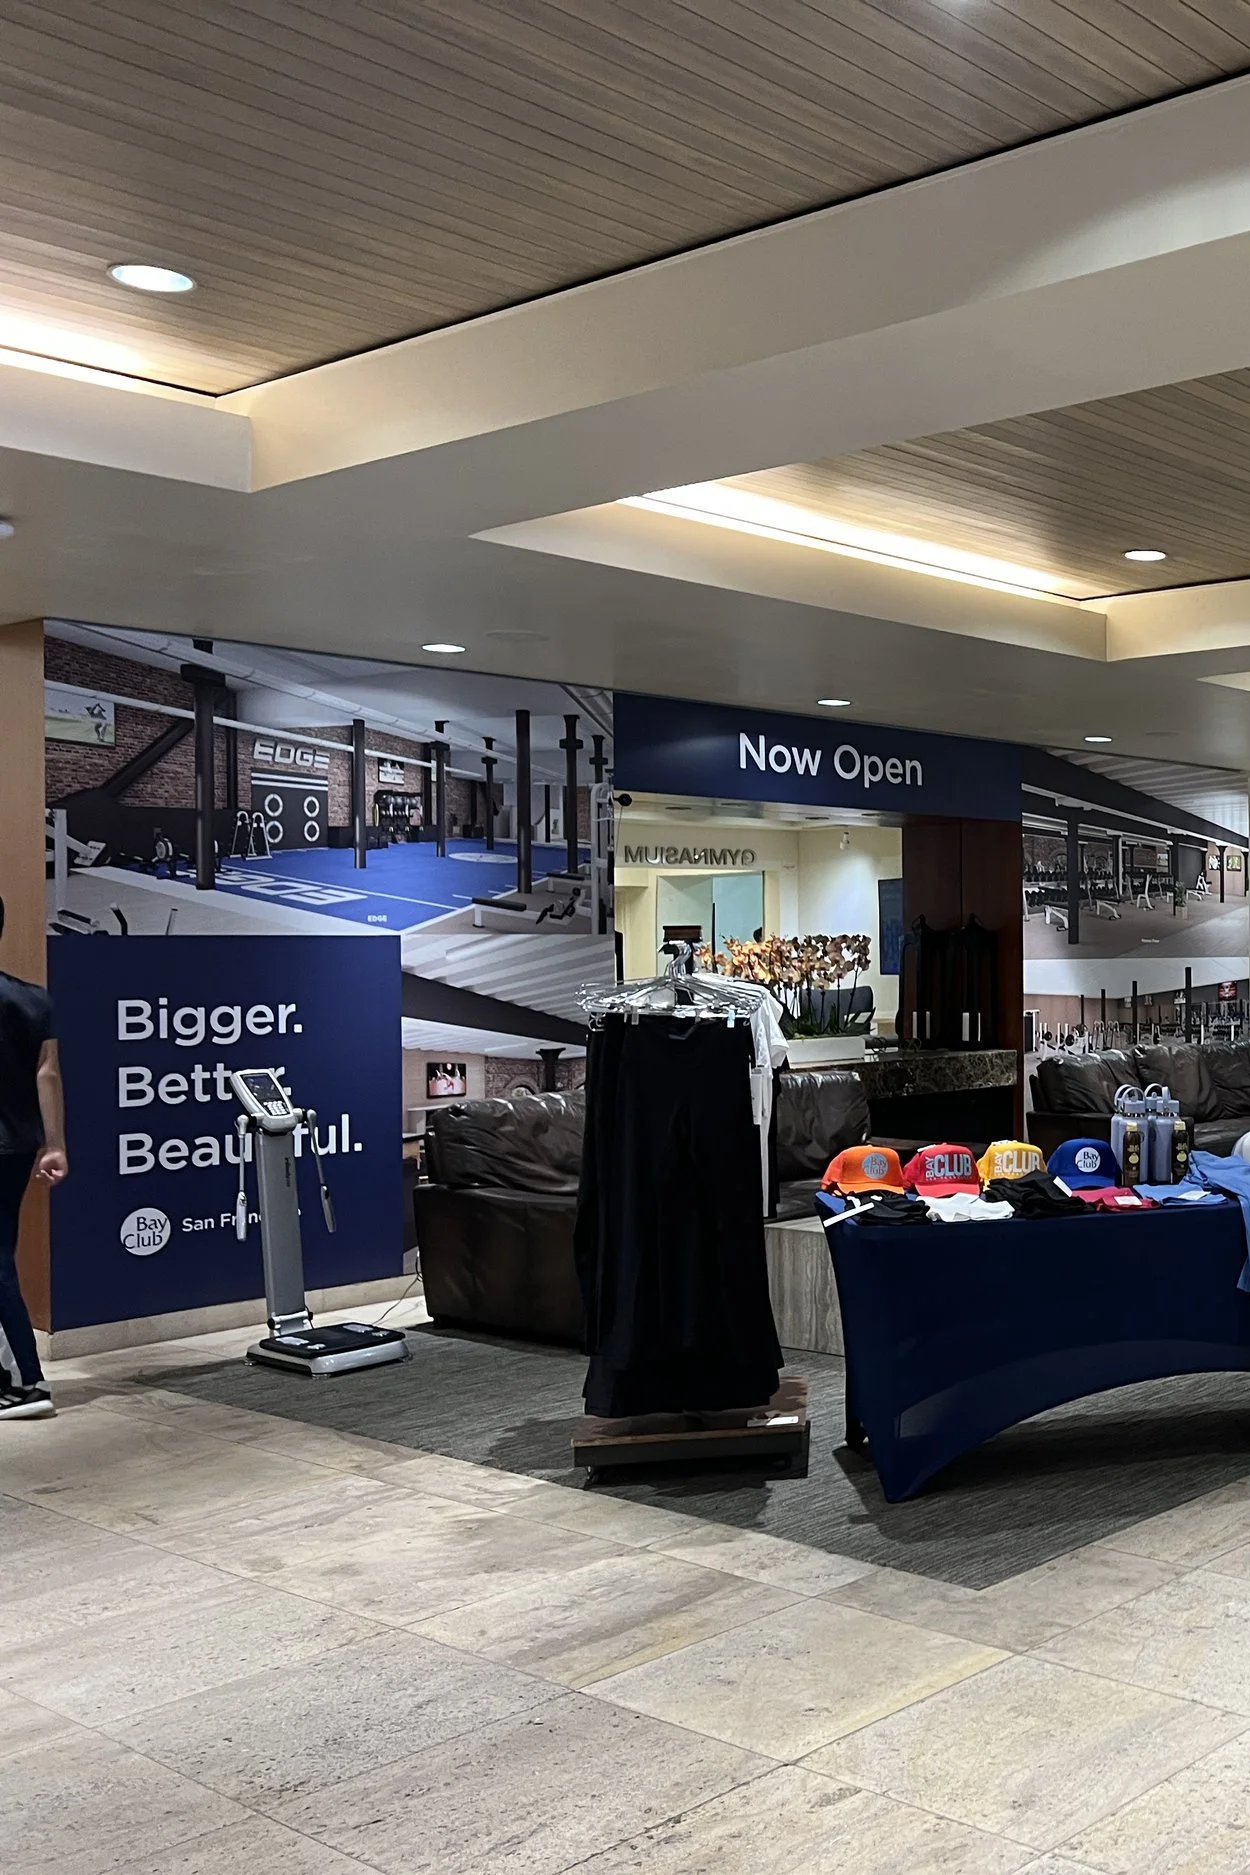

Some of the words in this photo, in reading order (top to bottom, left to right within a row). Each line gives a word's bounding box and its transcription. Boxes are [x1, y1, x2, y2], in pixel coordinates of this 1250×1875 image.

[253, 738, 330, 770] EDGE
[739, 732, 822, 777] Now
[833, 744, 923, 789] Open
[367, 914, 388, 923] EDGE
[117, 997, 303, 1047] Bigger.
[118, 1062, 292, 1108] Bett.
[119, 1113, 363, 1175] Beauful.
[871, 1156, 887, 1167] Bay
[934, 1153, 973, 1178] CLUB
[1076, 1160, 1097, 1169] Club
[1083, 1151, 1098, 1162] Bay
[925, 1156, 935, 1178] BAY
[136, 1216, 168, 1232] Bay
[182, 1217, 215, 1232] San
[123, 1231, 163, 1249] Club
